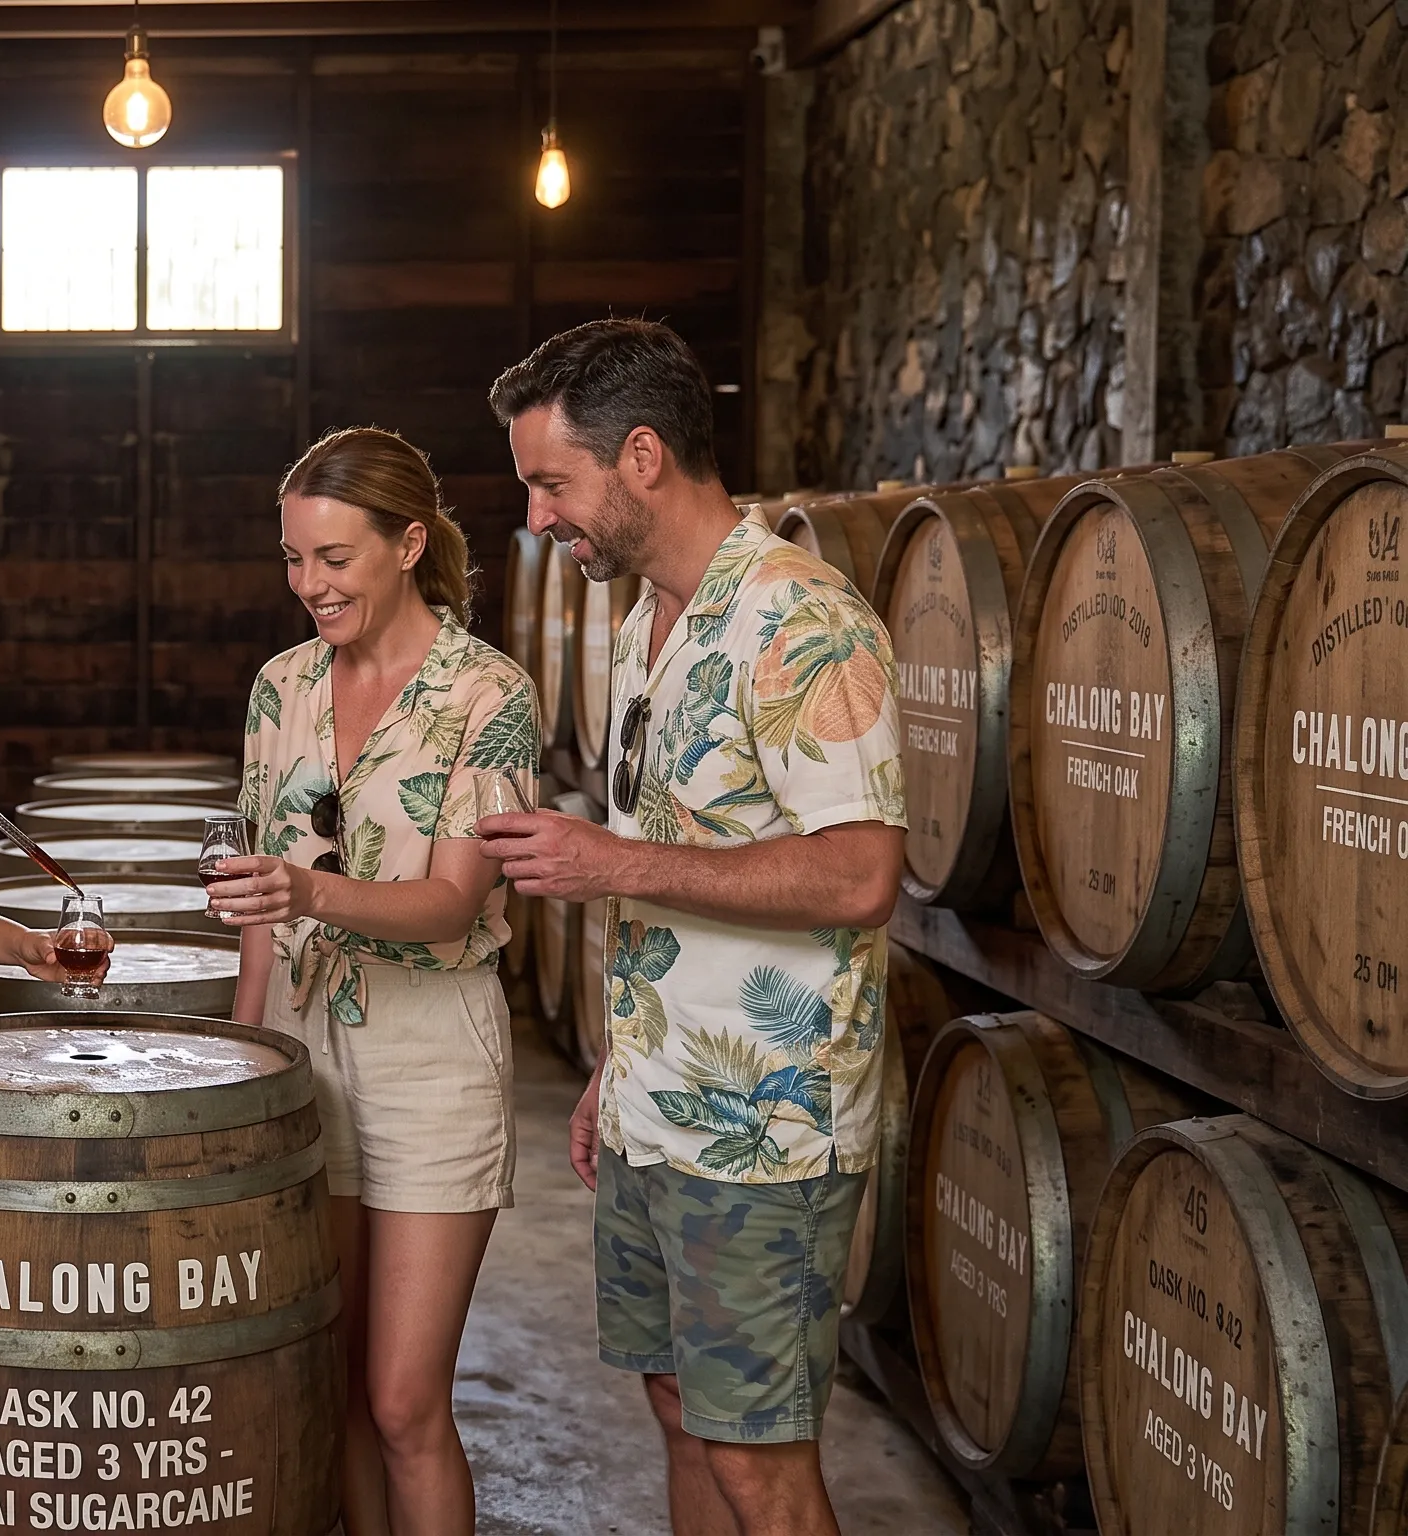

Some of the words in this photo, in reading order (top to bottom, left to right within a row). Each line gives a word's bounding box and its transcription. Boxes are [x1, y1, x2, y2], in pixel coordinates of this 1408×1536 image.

[1062, 592, 1108, 643] DISTILLED
[1128, 606, 1151, 649] 2018
[1311, 597, 1383, 667] DISTILLED
[951, 667, 977, 711] BAY
[1046, 682, 1122, 735] CHALONG
[1129, 690, 1165, 742] BAY
[940, 730, 959, 757] OAK
[1292, 710, 1408, 781] CHALONG
[1066, 755, 1111, 794] FRENCH
[1114, 765, 1139, 800] OAK
[1322, 805, 1391, 855] FRENCH
[1353, 953, 1371, 983] 25
[935, 1172, 994, 1251] CHALONG
[998, 1217, 1027, 1276] BAY
[1183, 1184, 1208, 1236] 46
[178, 1249, 262, 1311] BAY
[950, 1248, 976, 1290] AGED
[977, 1270, 984, 1299] 3
[987, 1275, 1007, 1319] YRS
[1187, 1280, 1209, 1323] NO.
[92, 1390, 156, 1429] NO.
[168, 1385, 213, 1424] 42
[1123, 1310, 1213, 1420] CHALONG
[1222, 1381, 1267, 1461] BAY
[96, 1443, 121, 1481] 3
[132, 1436, 208, 1479] YRS
[1143, 1408, 1183, 1467] AGED
[1186, 1443, 1197, 1480] 3
[1200, 1452, 1234, 1511] YRS
[29, 1477, 254, 1531] SUGARCANE
